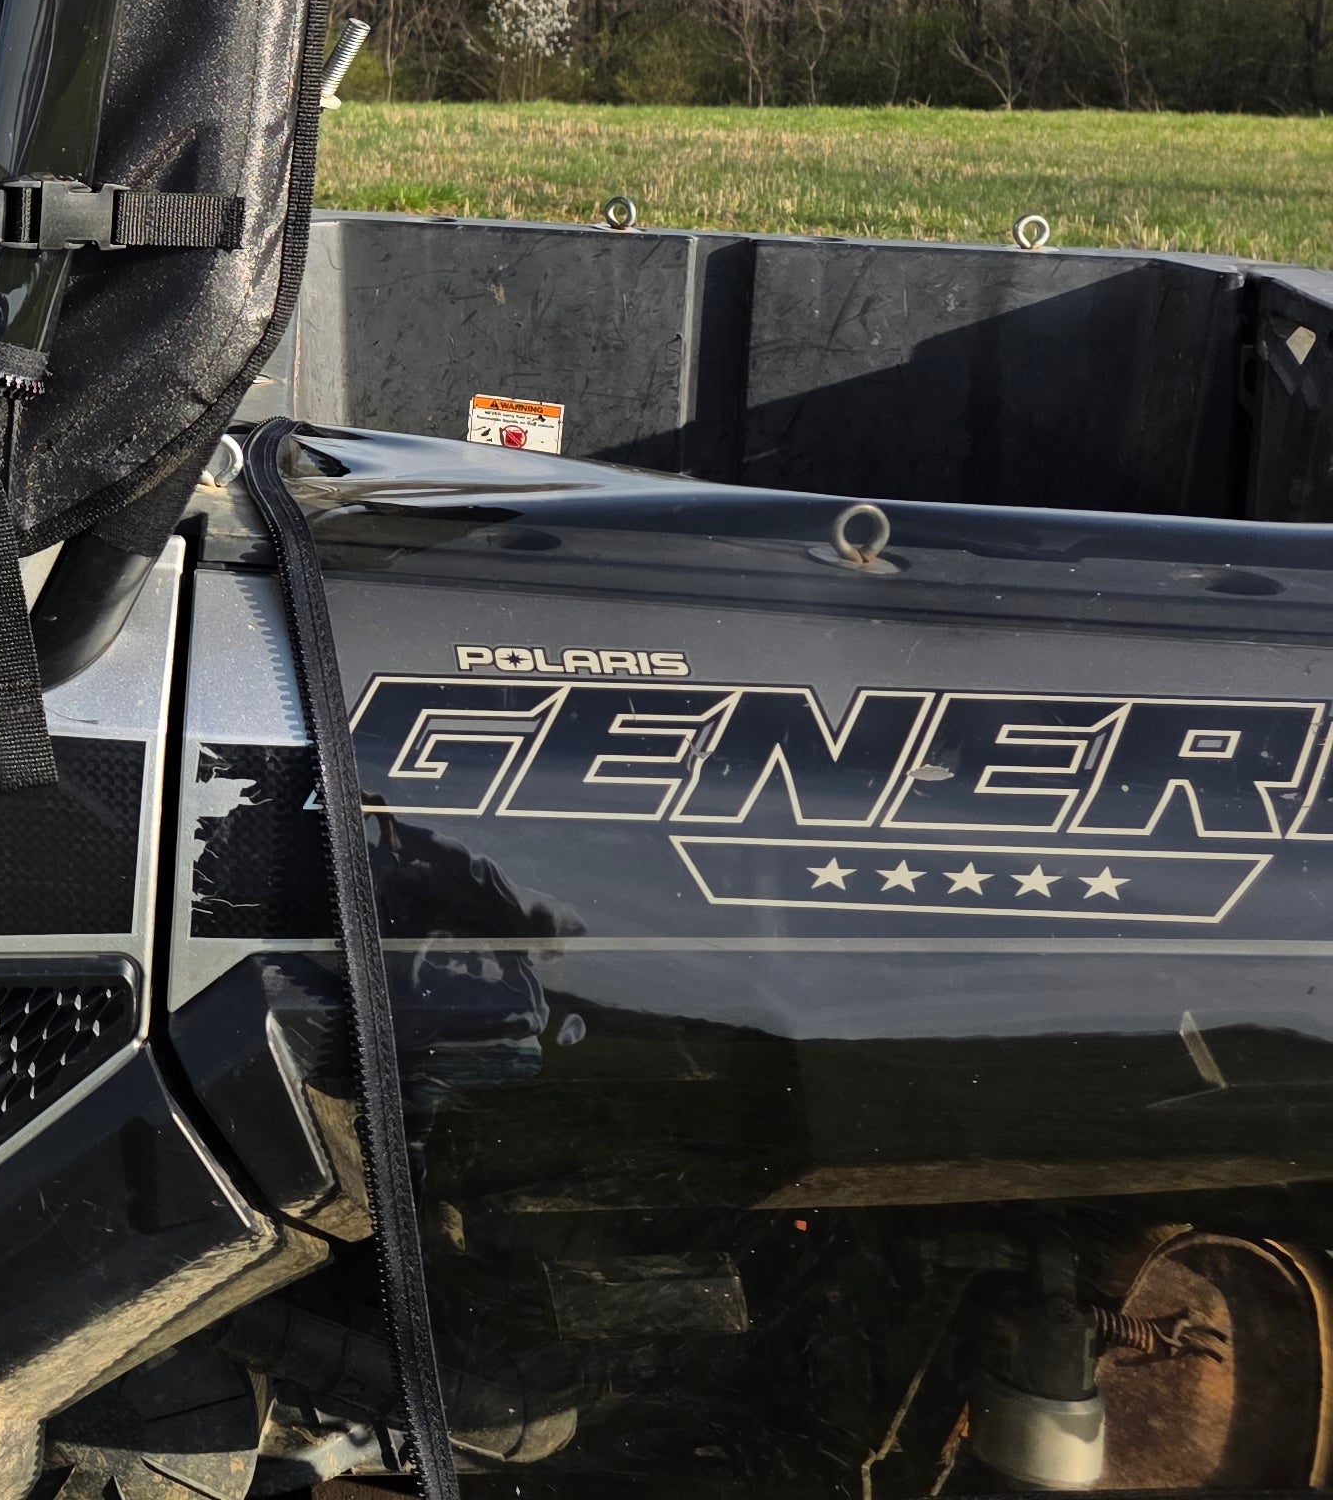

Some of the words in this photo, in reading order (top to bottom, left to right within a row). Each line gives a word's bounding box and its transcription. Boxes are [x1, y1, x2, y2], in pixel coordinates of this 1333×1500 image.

[500, 401, 544, 413] WARNING
[456, 646, 689, 676] POLARIS
[303, 676, 1333, 841] GENER
